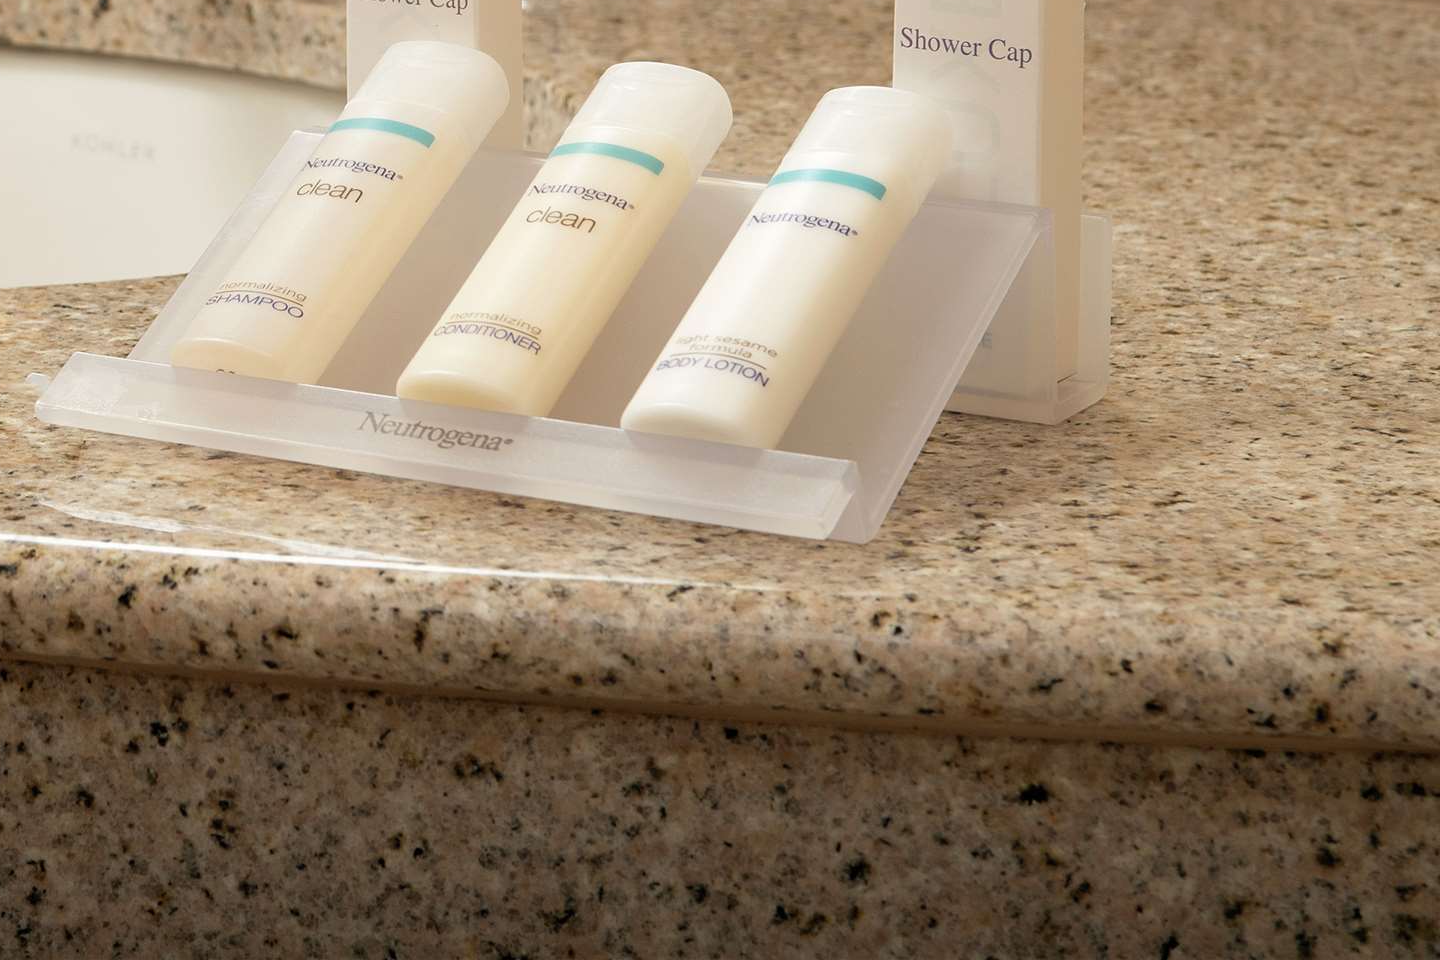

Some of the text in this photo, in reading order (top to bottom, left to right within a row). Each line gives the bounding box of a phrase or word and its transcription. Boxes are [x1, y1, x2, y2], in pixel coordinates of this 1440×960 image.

[900, 26, 1033, 69] Shower Cap
[296, 178, 364, 204] clean
[525, 205, 597, 234] clean
[219, 280, 308, 303] normalizing
[205, 293, 305, 319] SHAMPOO
[433, 323, 542, 356] CONDITIONER
[689, 342, 753, 359] formula
[713, 335, 778, 359] sesame
[656, 356, 771, 388] BODY LOTION
